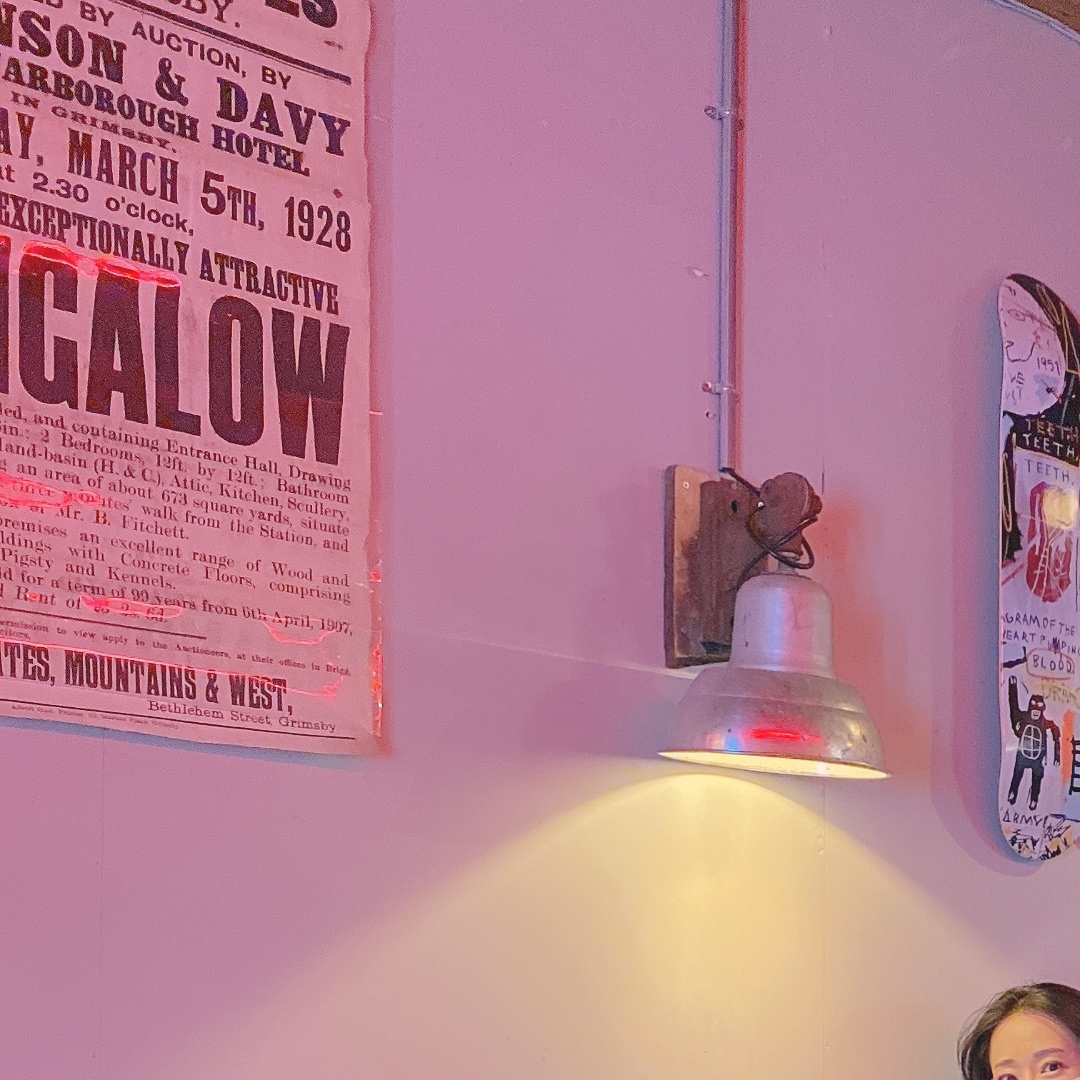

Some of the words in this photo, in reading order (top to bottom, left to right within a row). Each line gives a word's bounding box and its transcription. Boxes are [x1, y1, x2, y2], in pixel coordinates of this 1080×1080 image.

[80, 1, 114, 27] BY
[132, 21, 246, 78] AUCTION,
[261, 65, 292, 91] BY
[11, 91, 40, 109] IN
[51, 105, 178, 153] GRIMSBY.
[155, 57, 189, 106] &
[216, 77, 351, 156] DAVY
[211, 123, 310, 177] HOTEL
[32, 172, 89, 203] 2.30
[105, 196, 194, 236] o'clock,
[68, 128, 179, 204] MARCH
[200, 170, 265, 231] 5TH,
[284, 196, 351, 252] 1928
[0, 191, 190, 275] EXCEPTIONALLY
[199, 248, 339, 315] ATTRACTIVE
[0, 235, 350, 466] GALOW
[34, 415, 66, 430] and
[72, 422, 160, 452] containing
[166, 438, 238, 466] Entrance
[245, 455, 282, 477] Hall,
[288, 464, 352, 492] Drawing
[40, 428, 50, 443] 2
[62, 431, 145, 466] Bedrooms,
[198, 461, 216, 481] by
[277, 477, 350, 504] Bathroom
[16, 463, 38, 476] an
[45, 468, 81, 485] area
[87, 475, 104, 489] of
[108, 479, 154, 500] about
[161, 490, 188, 506] 673
[193, 500, 244, 517] square
[250, 509, 293, 528] yards,
[301, 516, 350, 537] situate
[123, 464, 136, 479] &
[170, 474, 213, 497] Attic,
[218, 482, 284, 509] Kitchen,
[94, 509, 111, 526] B.
[122, 514, 190, 540] Fitchett.
[141, 504, 179, 522] walk
[185, 510, 221, 529] from
[230, 519, 254, 535] the
[259, 525, 318, 548] Station,
[322, 538, 349, 553] and
[1, 547, 54, 573] Pigsty
[65, 563, 96, 577] and
[107, 566, 177, 590] Kennels.
[68, 545, 105, 562] with
[120, 551, 191, 577] Concrete
[204, 566, 256, 589] Floors,
[269, 580, 352, 606] comprising
[79, 531, 100, 545] an
[110, 537, 182, 559] excellent
[192, 550, 235, 570] range
[246, 559, 262, 573] of
[271, 561, 314, 582] Wood
[322, 574, 350, 588] and
[20, 570, 45, 586] for
[51, 577, 60, 589] a
[67, 580, 106, 596] term
[111, 586, 127, 600] of
[155, 594, 197, 611] years
[202, 599, 238, 617] from
[271, 610, 314, 630] April,
[73, 629, 97, 640] view
[65, 649, 197, 700] MOUNTAINS
[205, 668, 219, 704] &
[228, 673, 293, 716] WEST,
[148, 699, 224, 720] Bethlehem
[230, 710, 273, 727] Street,
[279, 716, 337, 734] Grimsby
